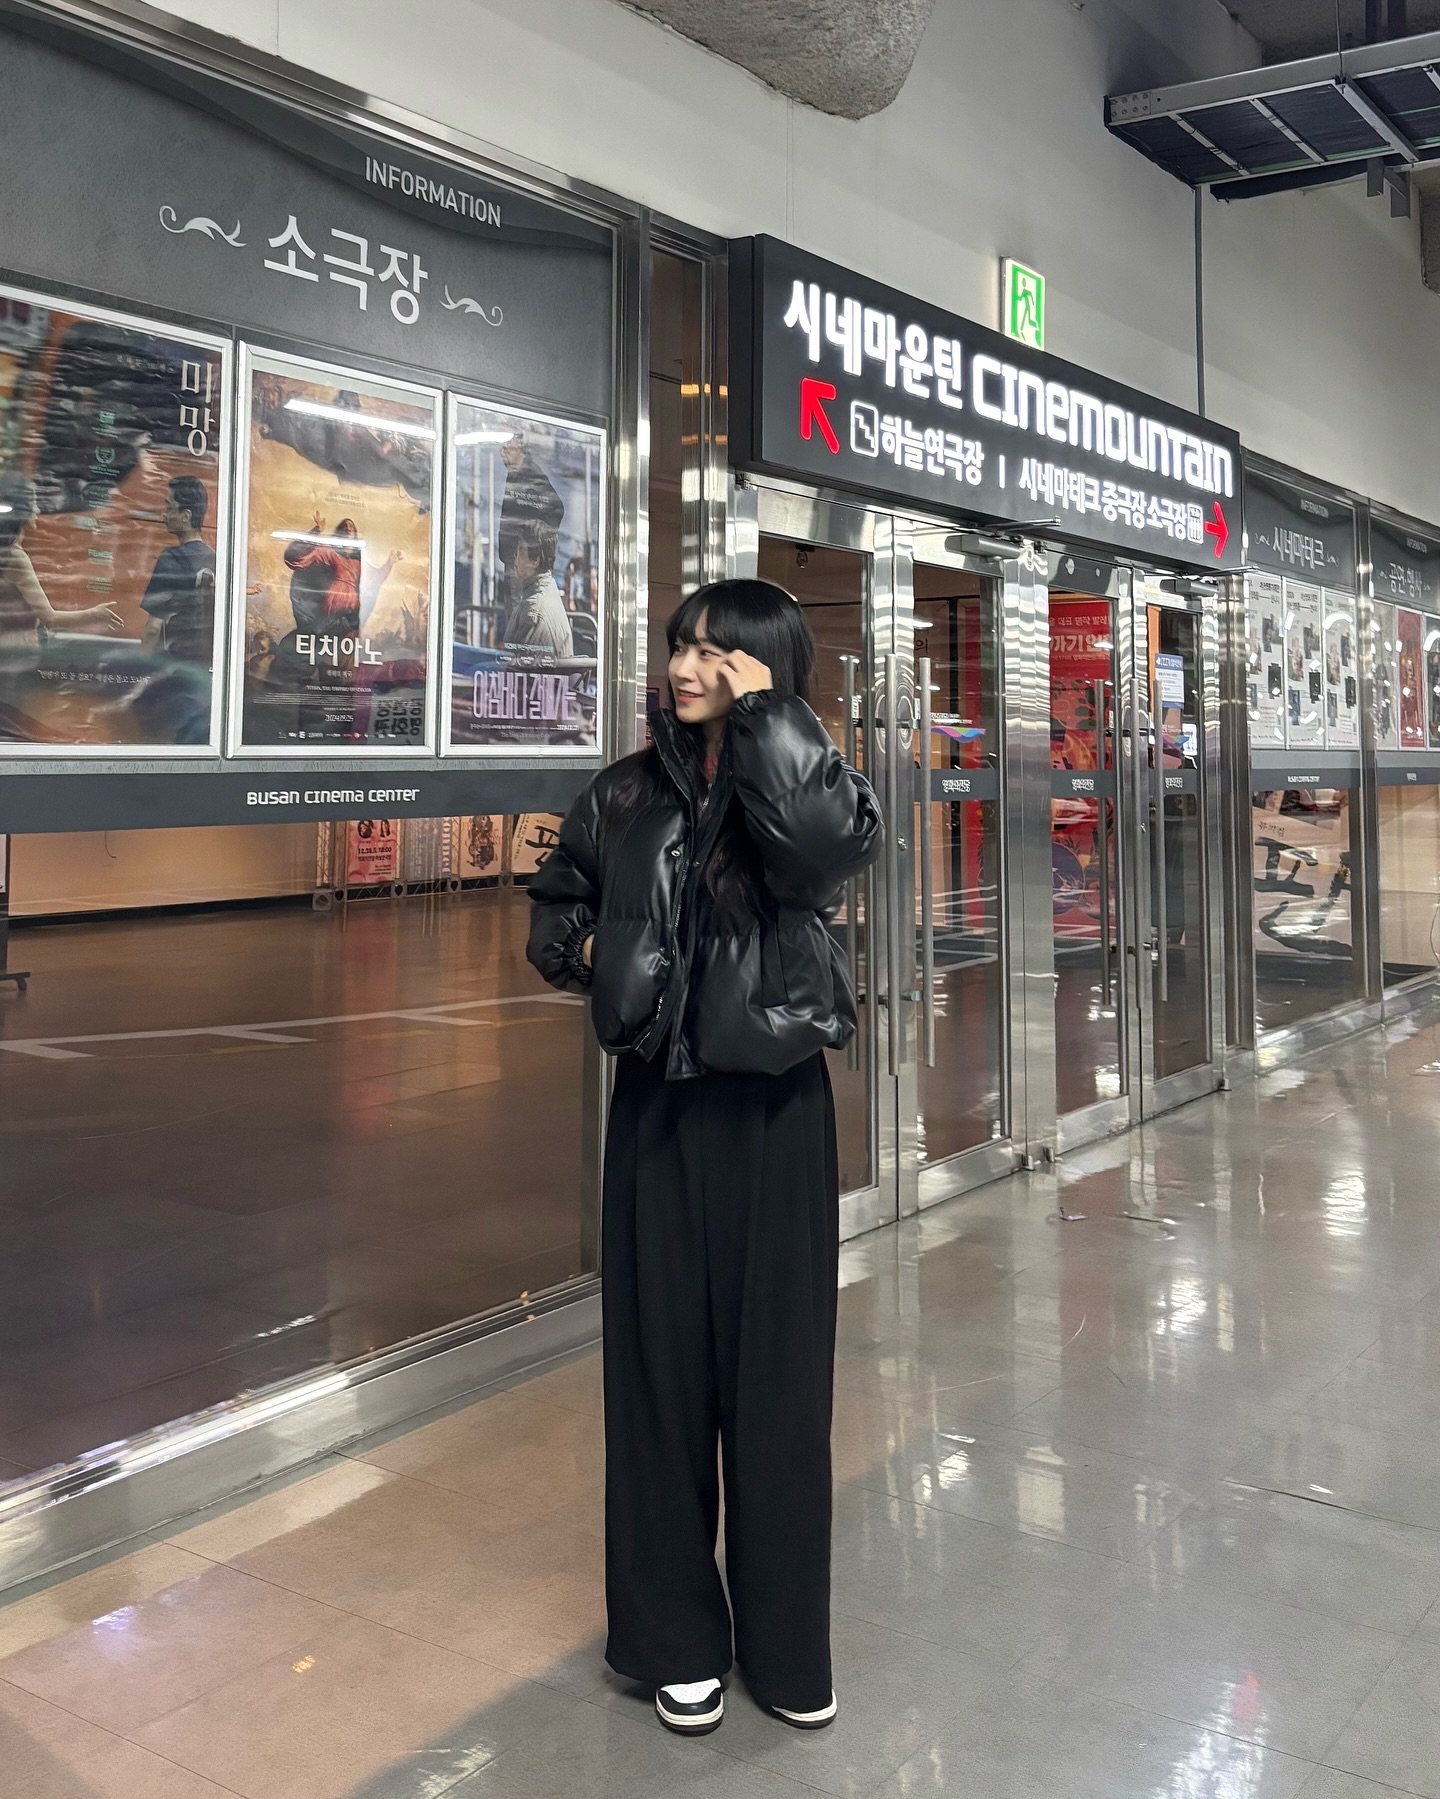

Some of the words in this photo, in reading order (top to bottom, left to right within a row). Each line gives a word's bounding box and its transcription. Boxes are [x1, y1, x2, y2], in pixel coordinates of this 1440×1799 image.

[366, 156, 501, 228] INFORMATION
[264, 214, 429, 325] 소극장
[783, 279, 963, 410] 시네마운틴
[179, 359, 216, 457] 미망
[880, 414, 985, 487] 하늘연극장
[1018, 457, 1102, 515] 시네마테크
[1102, 480, 1148, 530] 중극장
[1147, 495, 1188, 541] 소극장
[1273, 526, 1325, 570] 시네마테크
[295, 633, 384, 668] 티치아노
